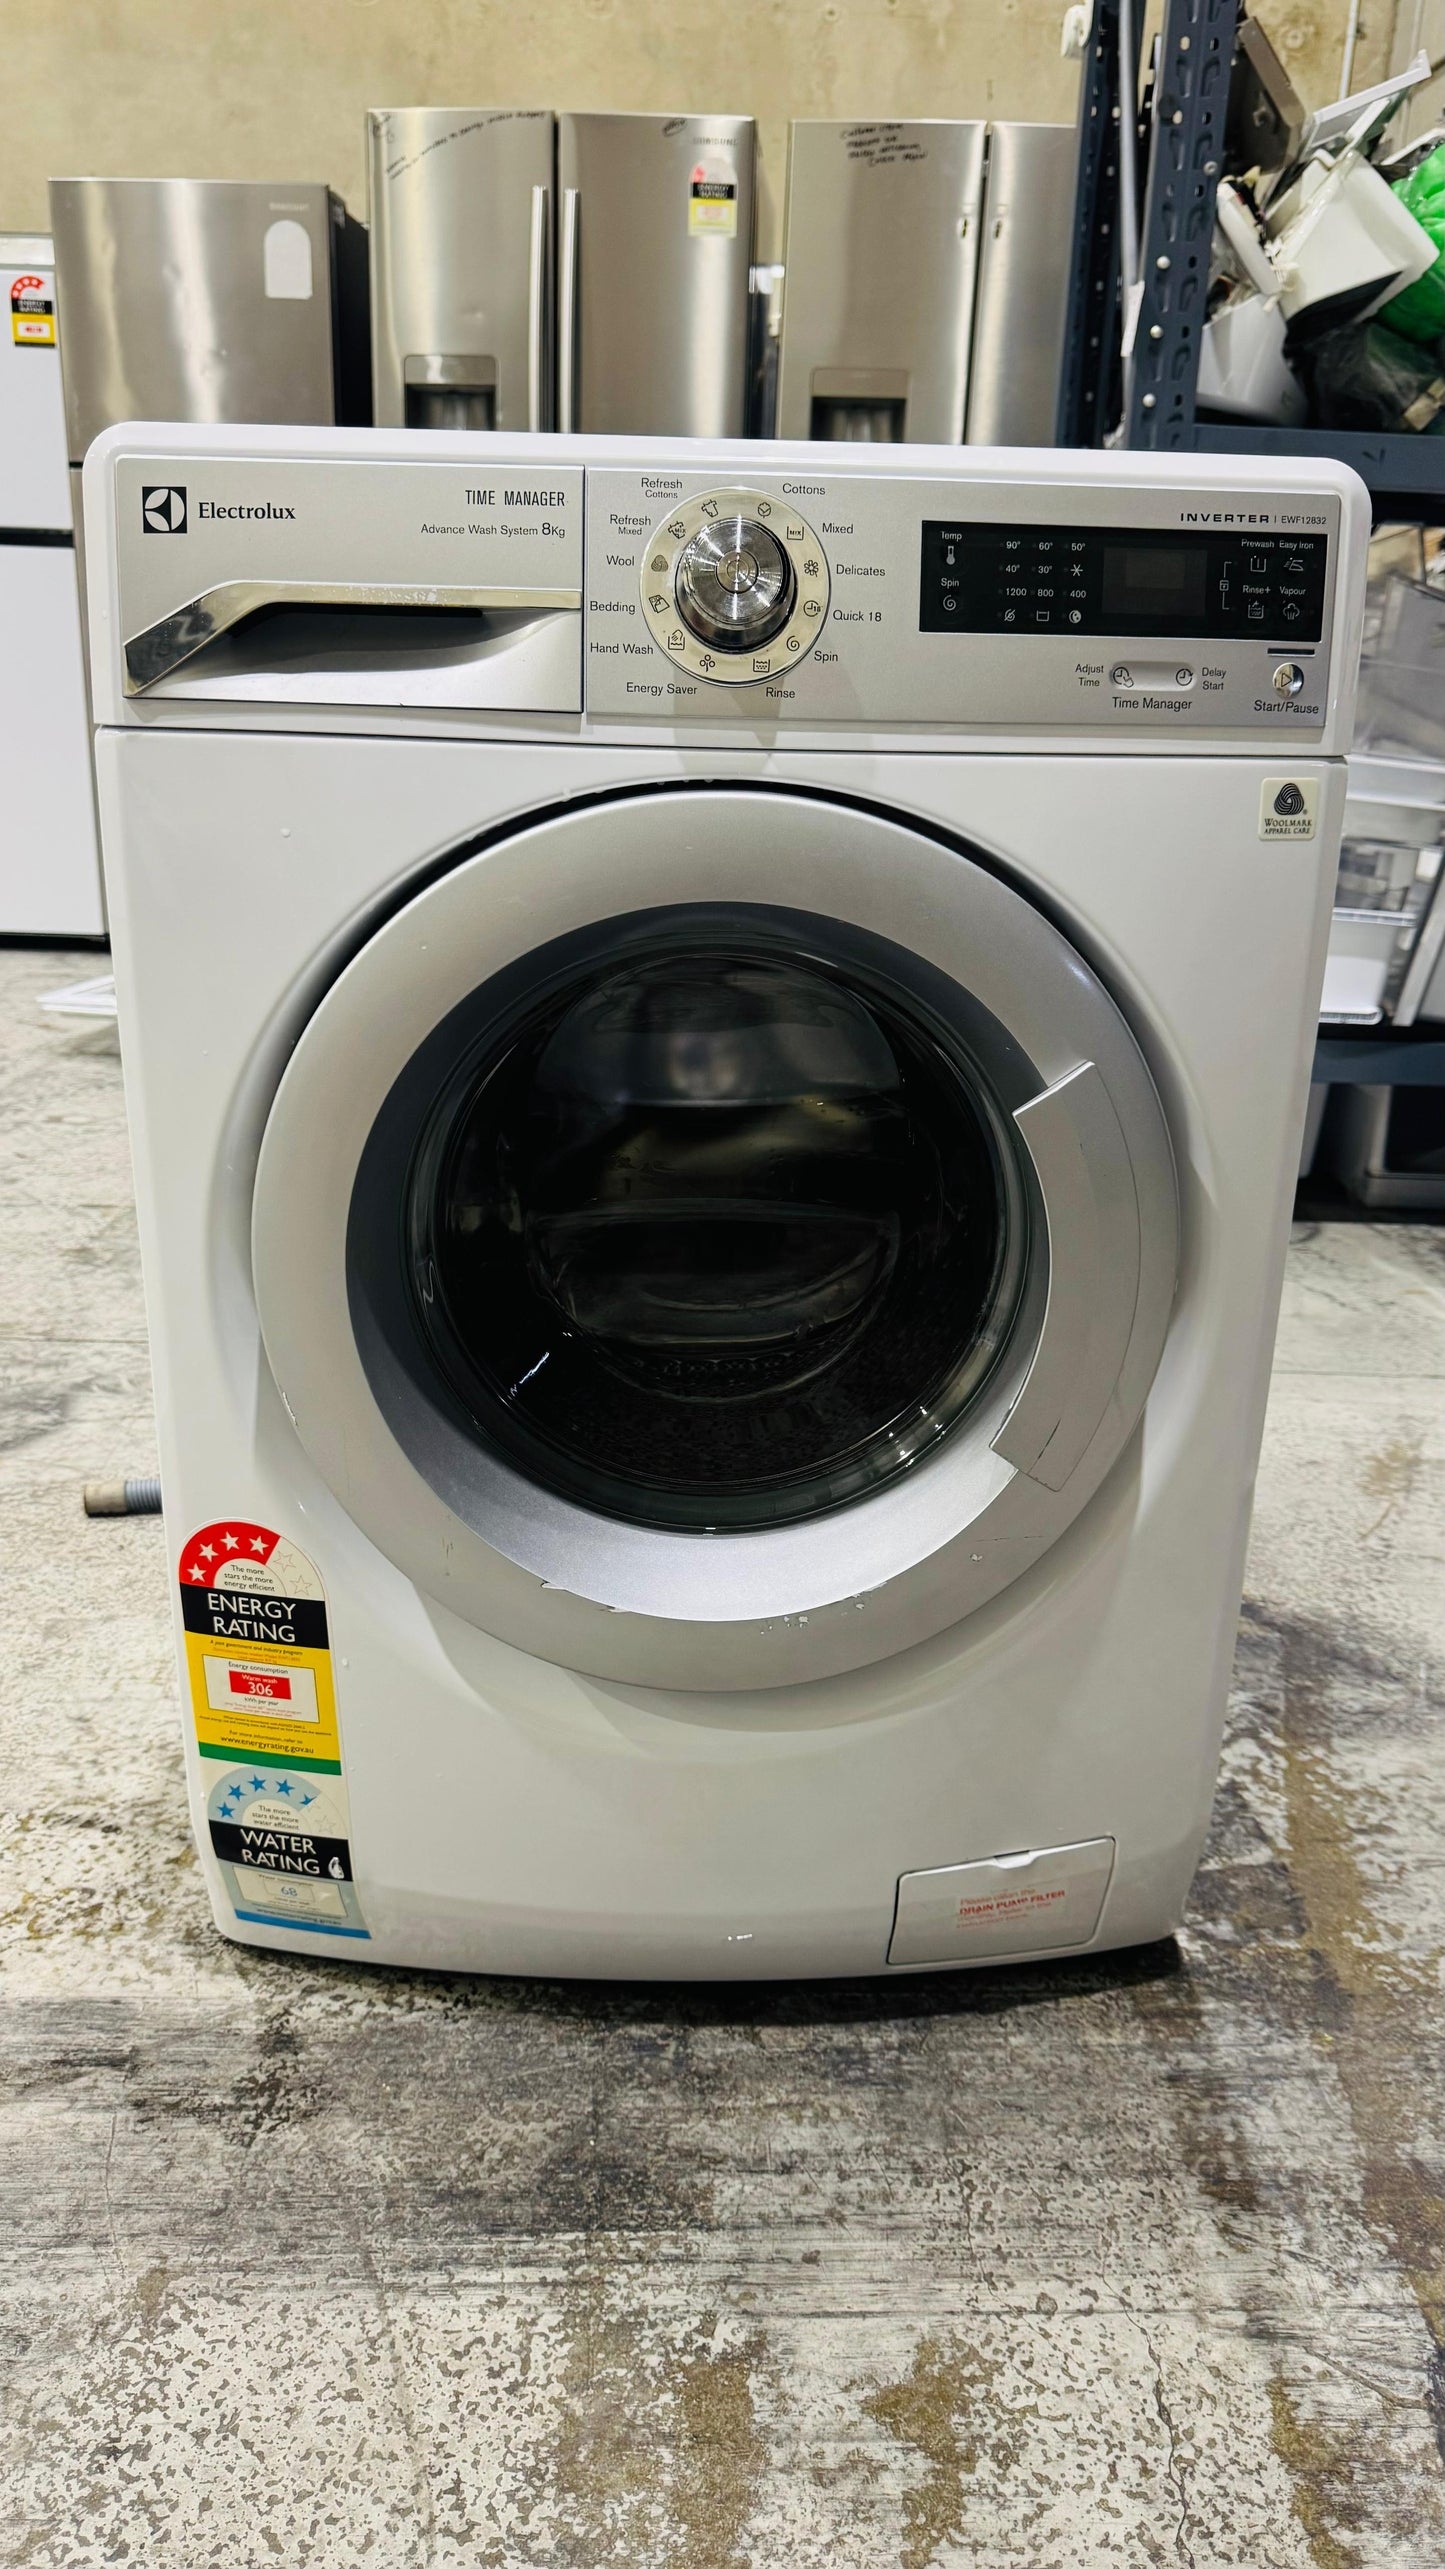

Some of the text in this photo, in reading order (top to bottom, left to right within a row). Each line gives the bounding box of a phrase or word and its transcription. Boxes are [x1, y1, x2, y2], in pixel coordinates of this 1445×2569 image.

[641, 477, 683, 489] Refresh
[782, 483, 826, 495] Cottons
[465, 489, 565, 507] TIME MANAGER
[645, 489, 678, 499] Cottons
[198, 501, 297, 520] Electrolux
[609, 514, 652, 526] Refresh
[1180, 513, 1327, 525] INVERTER EWF12832
[420, 522, 566, 539] Advance Wash System 8Kg
[618, 526, 643, 536] Mixed
[822, 522, 854, 534] Mixed
[940, 531, 963, 542] Temp
[1241, 538, 1275, 548] Prewash
[1279, 540, 1315, 551] Easy Iron
[606, 555, 635, 567] Wool
[836, 563, 886, 577] Delicates
[940, 577, 960, 589] Spin
[1242, 584, 1271, 594] Rinse+
[1006, 587, 1027, 597] 1200
[1037, 588, 1054, 598] 800
[1070, 589, 1087, 599] 400
[1279, 585, 1307, 597] Vapour
[589, 600, 636, 616] Bedding
[833, 609, 882, 622] Quick 18
[590, 642, 654, 655] Hand Wash
[814, 650, 839, 664] Spin
[1075, 663, 1105, 675] Adjust
[1202, 667, 1227, 679] Delay
[1078, 677, 1100, 687] Time
[1202, 680, 1224, 691] Start
[626, 681, 698, 697] Energy Saver
[765, 687, 796, 699] Rinse
[1112, 697, 1192, 711] Time Manager
[1254, 699, 1319, 715] Start/Pause
[1264, 818, 1313, 828] WOOLMARK
[1264, 827, 1292, 835] APPAREL
[231, 1564, 244, 1573] The
[241, 1574, 253, 1582] the
[224, 1580, 275, 1592] energy efficient
[207, 1592, 297, 1620] ENERGY
[213, 1615, 296, 1643] RATING
[228, 1661, 289, 1675] Energy consumption
[242, 1673, 261, 1682] Warm
[248, 1681, 274, 1696] 306
[258, 1804, 272, 1813] The
[252, 1811, 269, 1819] stars
[254, 1818, 272, 1827] water
[240, 1828, 317, 1855] WATER
[241, 1848, 320, 1875] RATING
[280, 1885, 298, 1897] 68
[960, 1903, 994, 1915] DRAIN
[996, 1896, 1028, 1909] PUMP
[1030, 1890, 1066, 1902] FILTER
